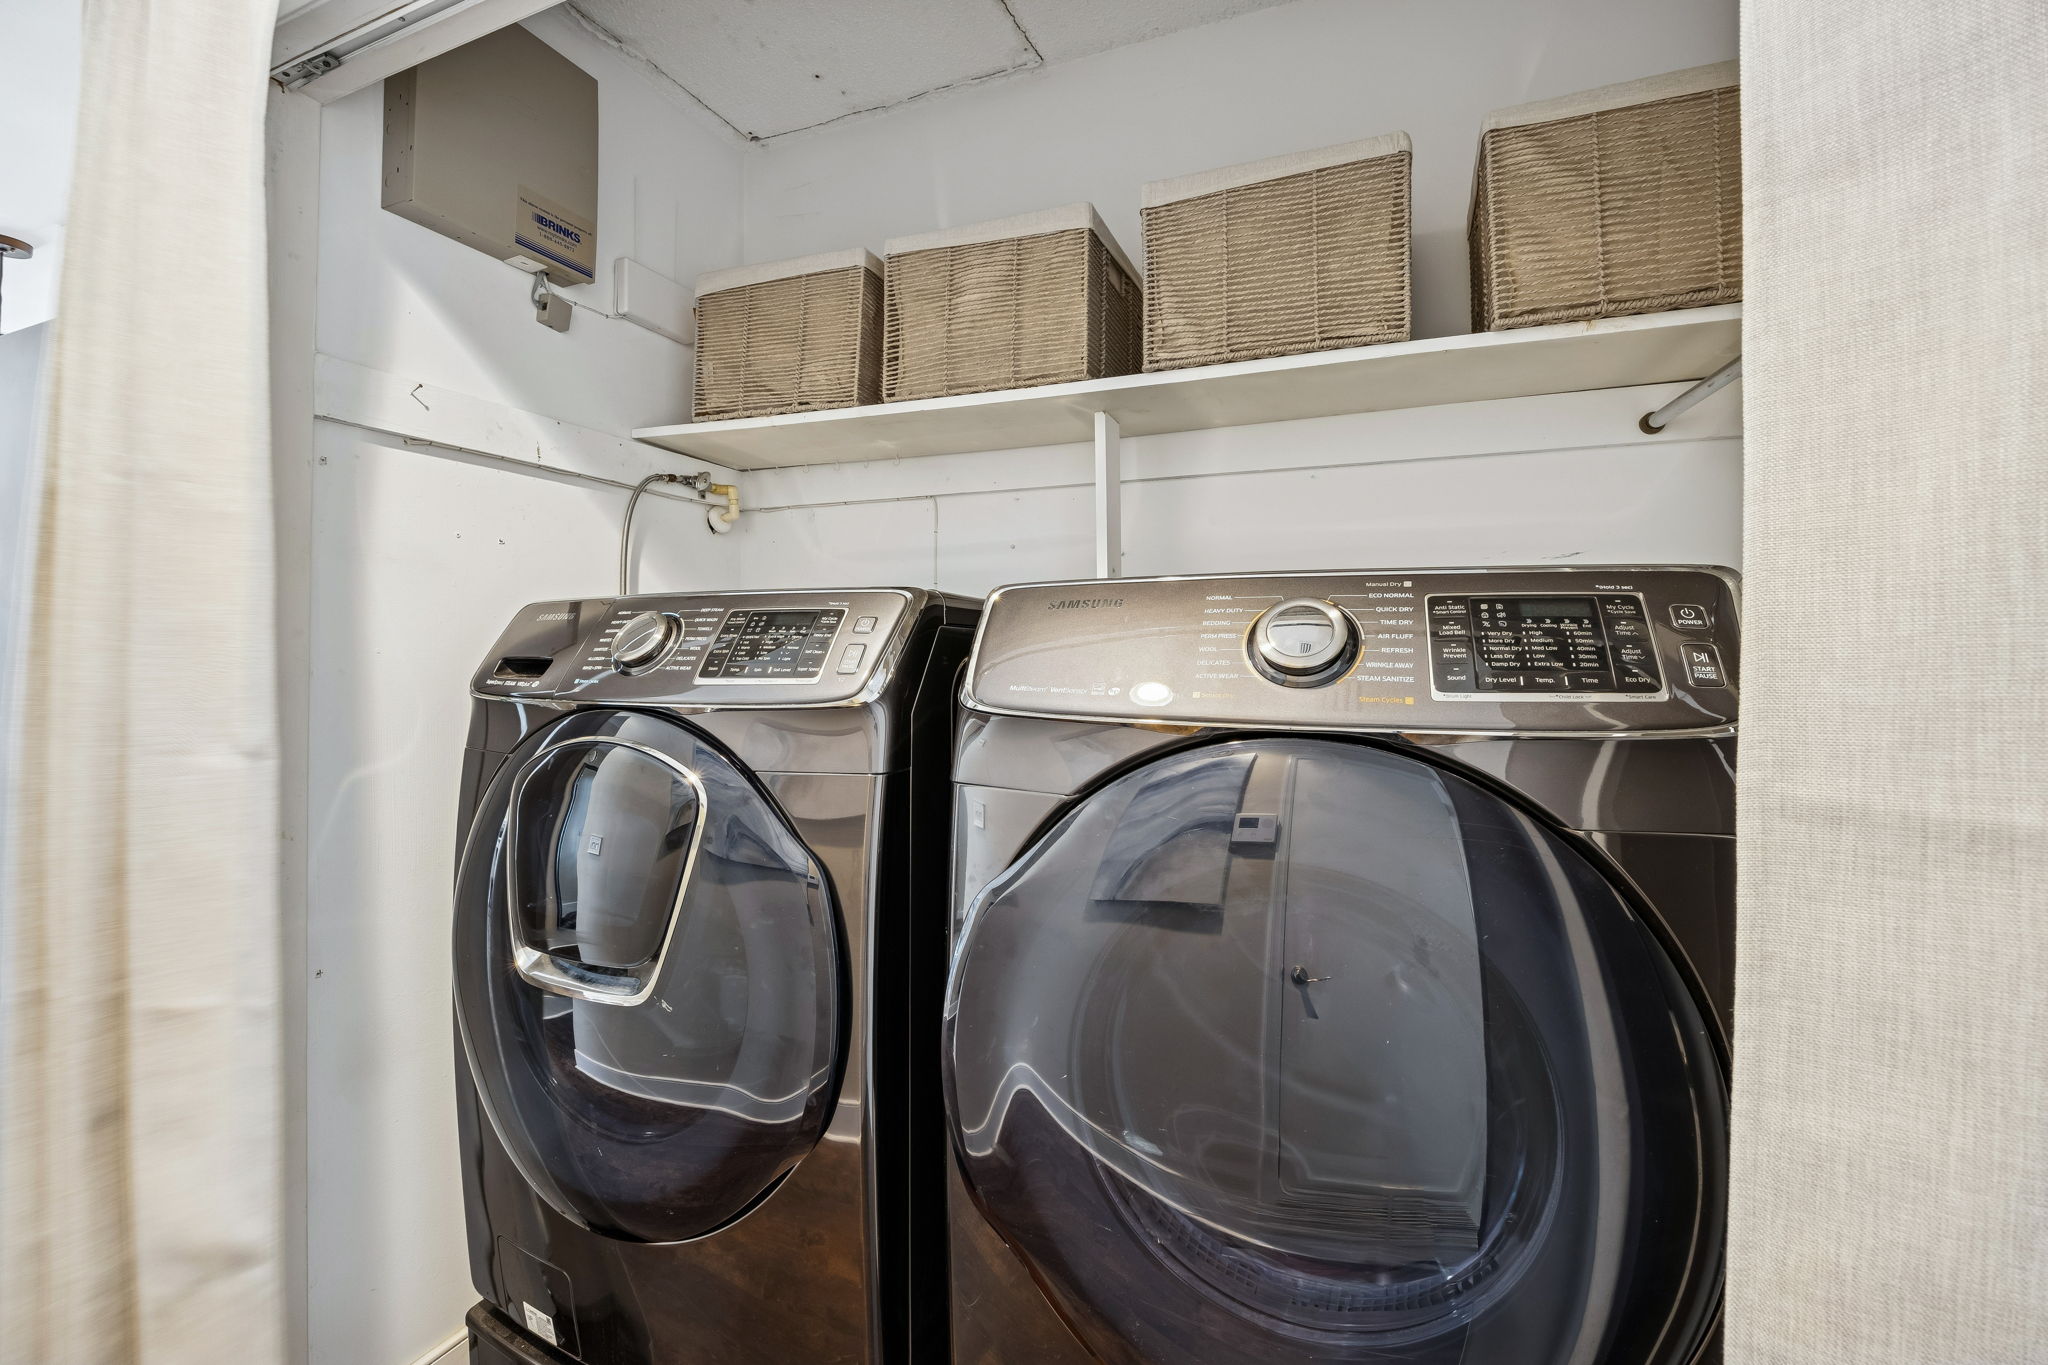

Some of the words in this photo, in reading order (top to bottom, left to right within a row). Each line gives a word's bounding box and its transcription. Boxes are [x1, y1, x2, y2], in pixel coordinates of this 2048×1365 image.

[540, 215, 581, 244] BRINKS
[1048, 599, 1123, 609] SAMSUNG
[536, 613, 576, 621] SAMSUNG
